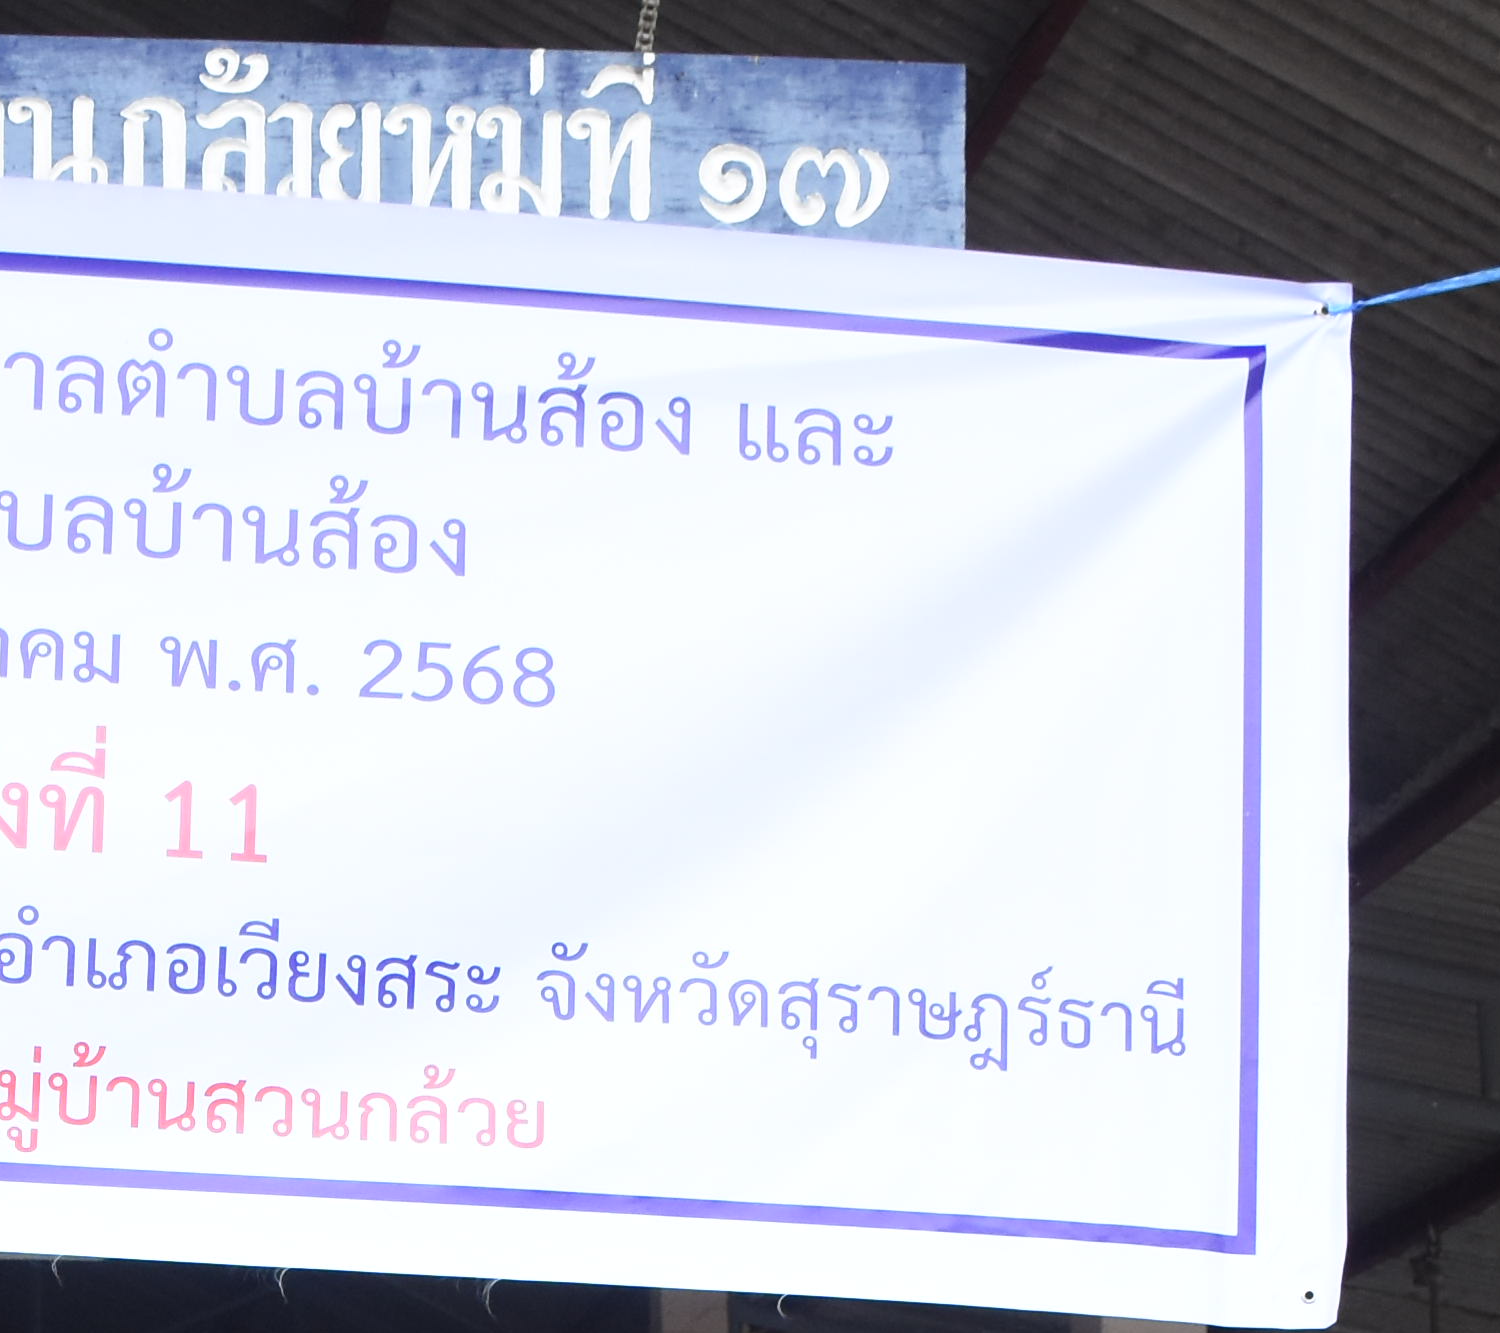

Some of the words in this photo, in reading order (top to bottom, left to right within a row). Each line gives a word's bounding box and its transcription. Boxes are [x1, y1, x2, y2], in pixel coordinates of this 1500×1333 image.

[698, 143, 890, 228] ๑๗
[738, 402, 895, 467] และ
[159, 635, 320, 697] พ.ศ.
[358, 638, 556, 708] 2568
[164, 780, 268, 864] 11
[535, 941, 1188, 1073] จังหวัดสุราษฎร์ธานี
